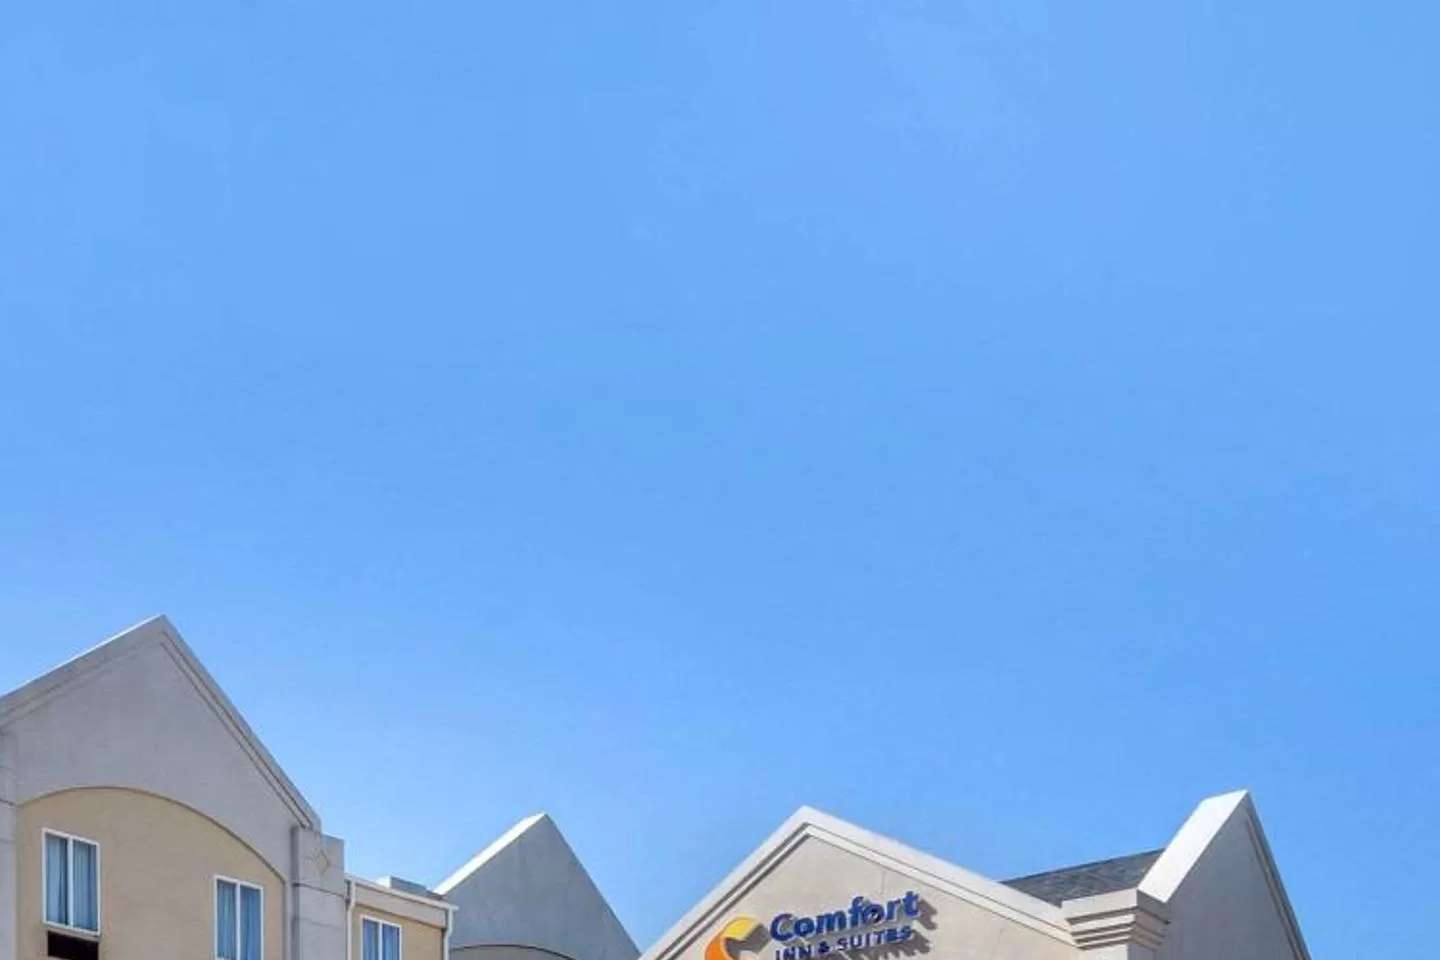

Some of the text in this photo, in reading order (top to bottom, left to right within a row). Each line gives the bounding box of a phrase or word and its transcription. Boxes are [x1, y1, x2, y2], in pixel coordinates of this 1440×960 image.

[769, 890, 920, 942] Comfort
[817, 940, 831, 955] &
[837, 925, 912, 951] SUITES
